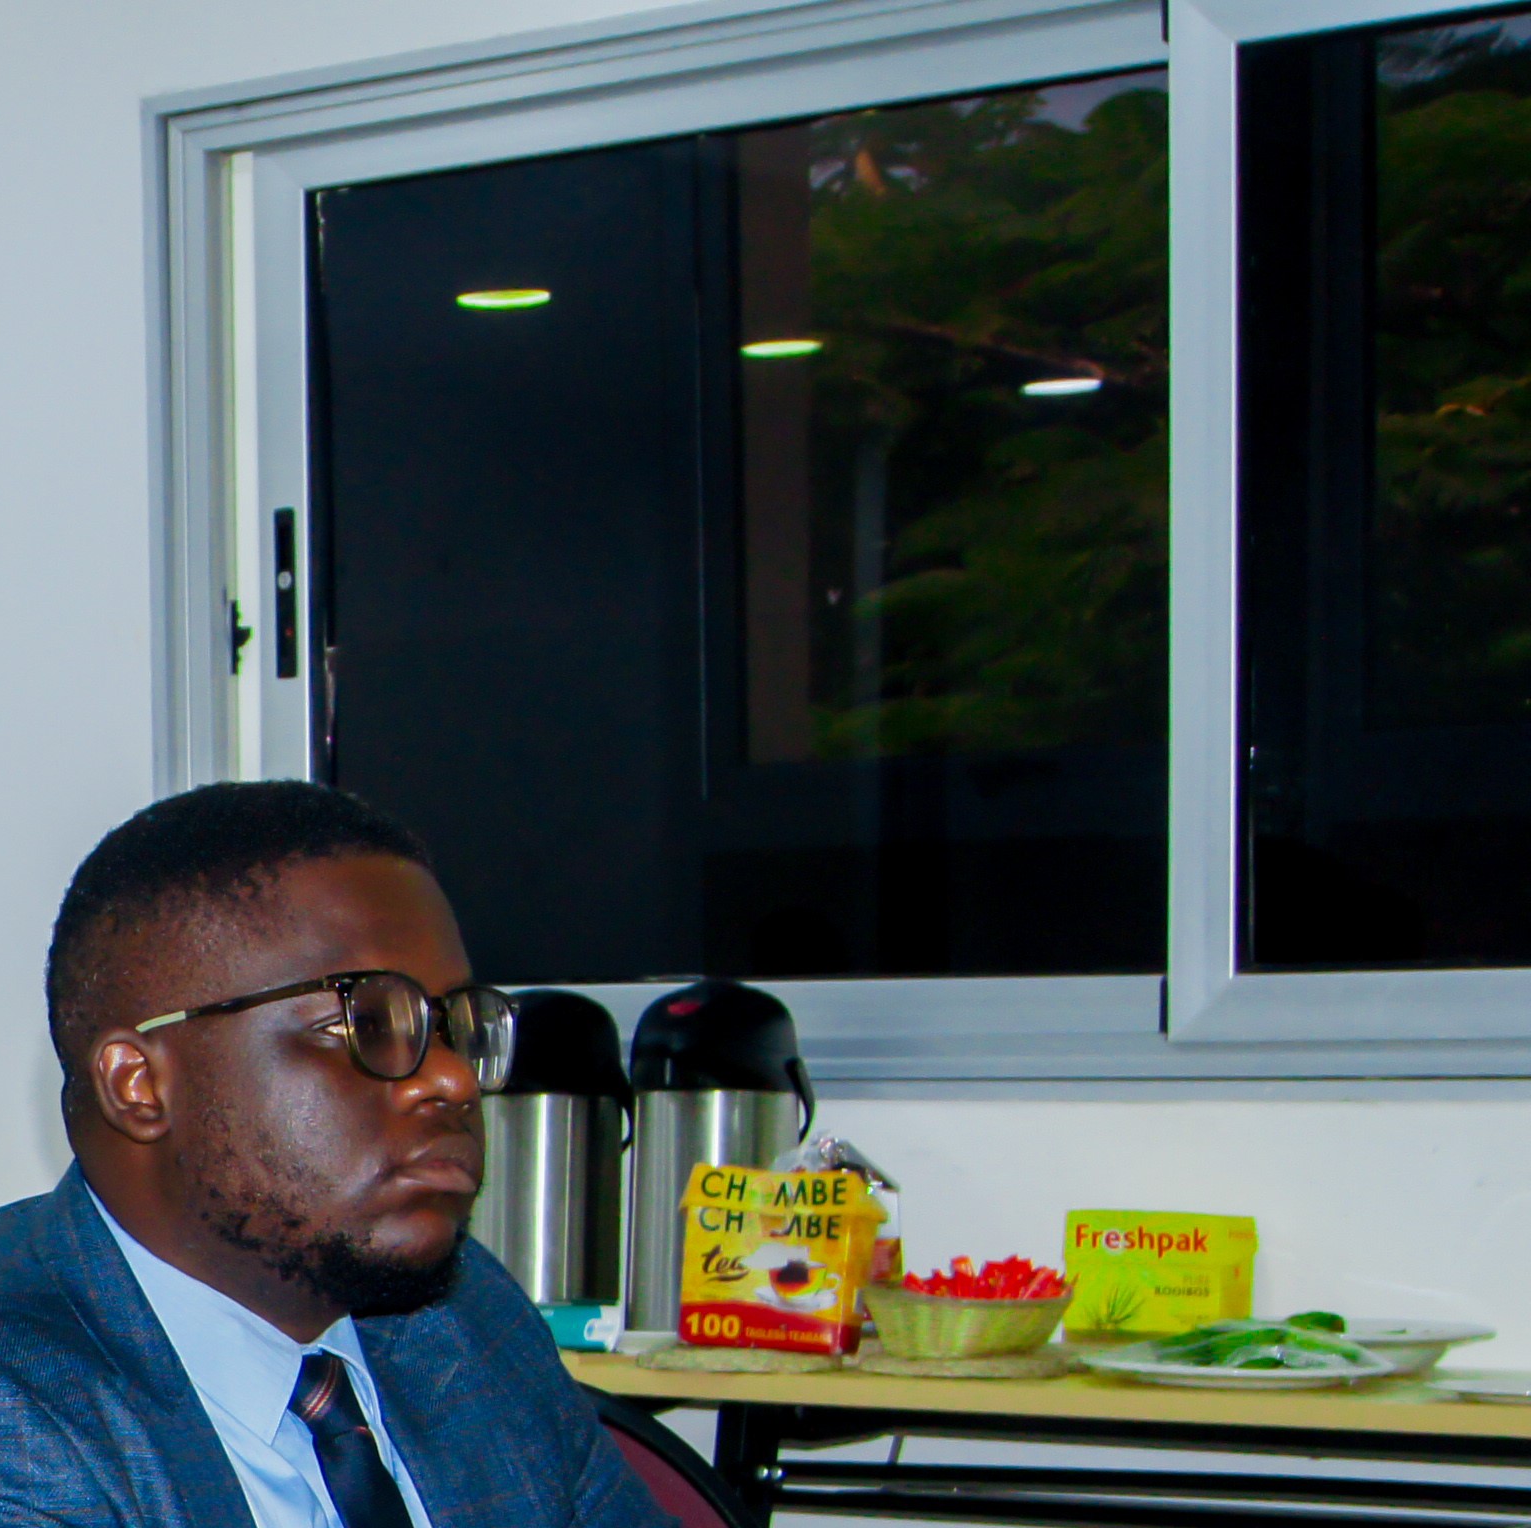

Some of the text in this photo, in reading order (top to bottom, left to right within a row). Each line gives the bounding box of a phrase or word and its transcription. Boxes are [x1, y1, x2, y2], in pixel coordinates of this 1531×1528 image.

[701, 1171, 848, 1207] CHMBE
[1075, 1223, 1208, 1259] Freshpak
[701, 1244, 747, 1277] tea
[685, 1312, 741, 1339] 100
